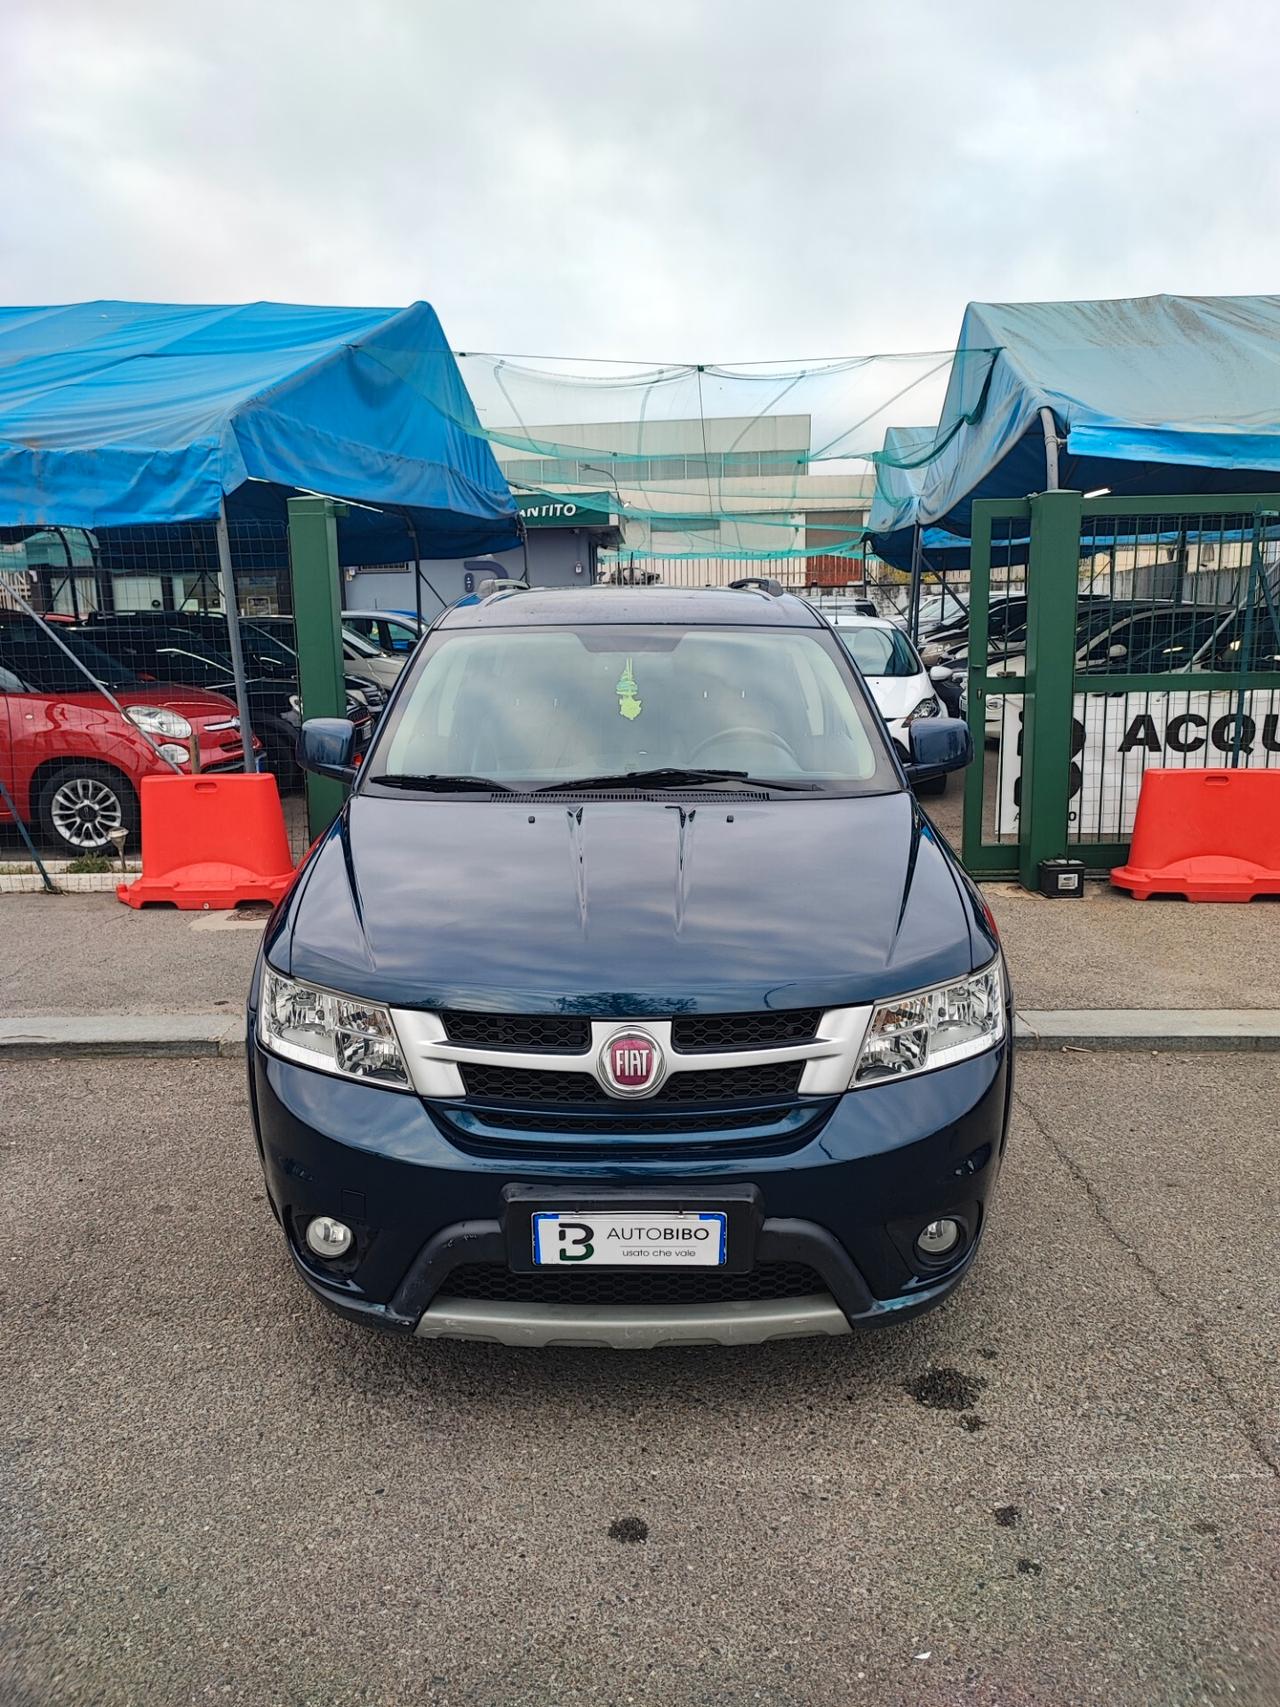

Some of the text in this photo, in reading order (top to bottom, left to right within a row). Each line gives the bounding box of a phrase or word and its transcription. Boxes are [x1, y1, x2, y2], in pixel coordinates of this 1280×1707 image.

[615, 1049, 650, 1077] FIAT
[606, 1227, 710, 1241] AUTOBIBO
[622, 1247, 697, 1258] usato che vale
